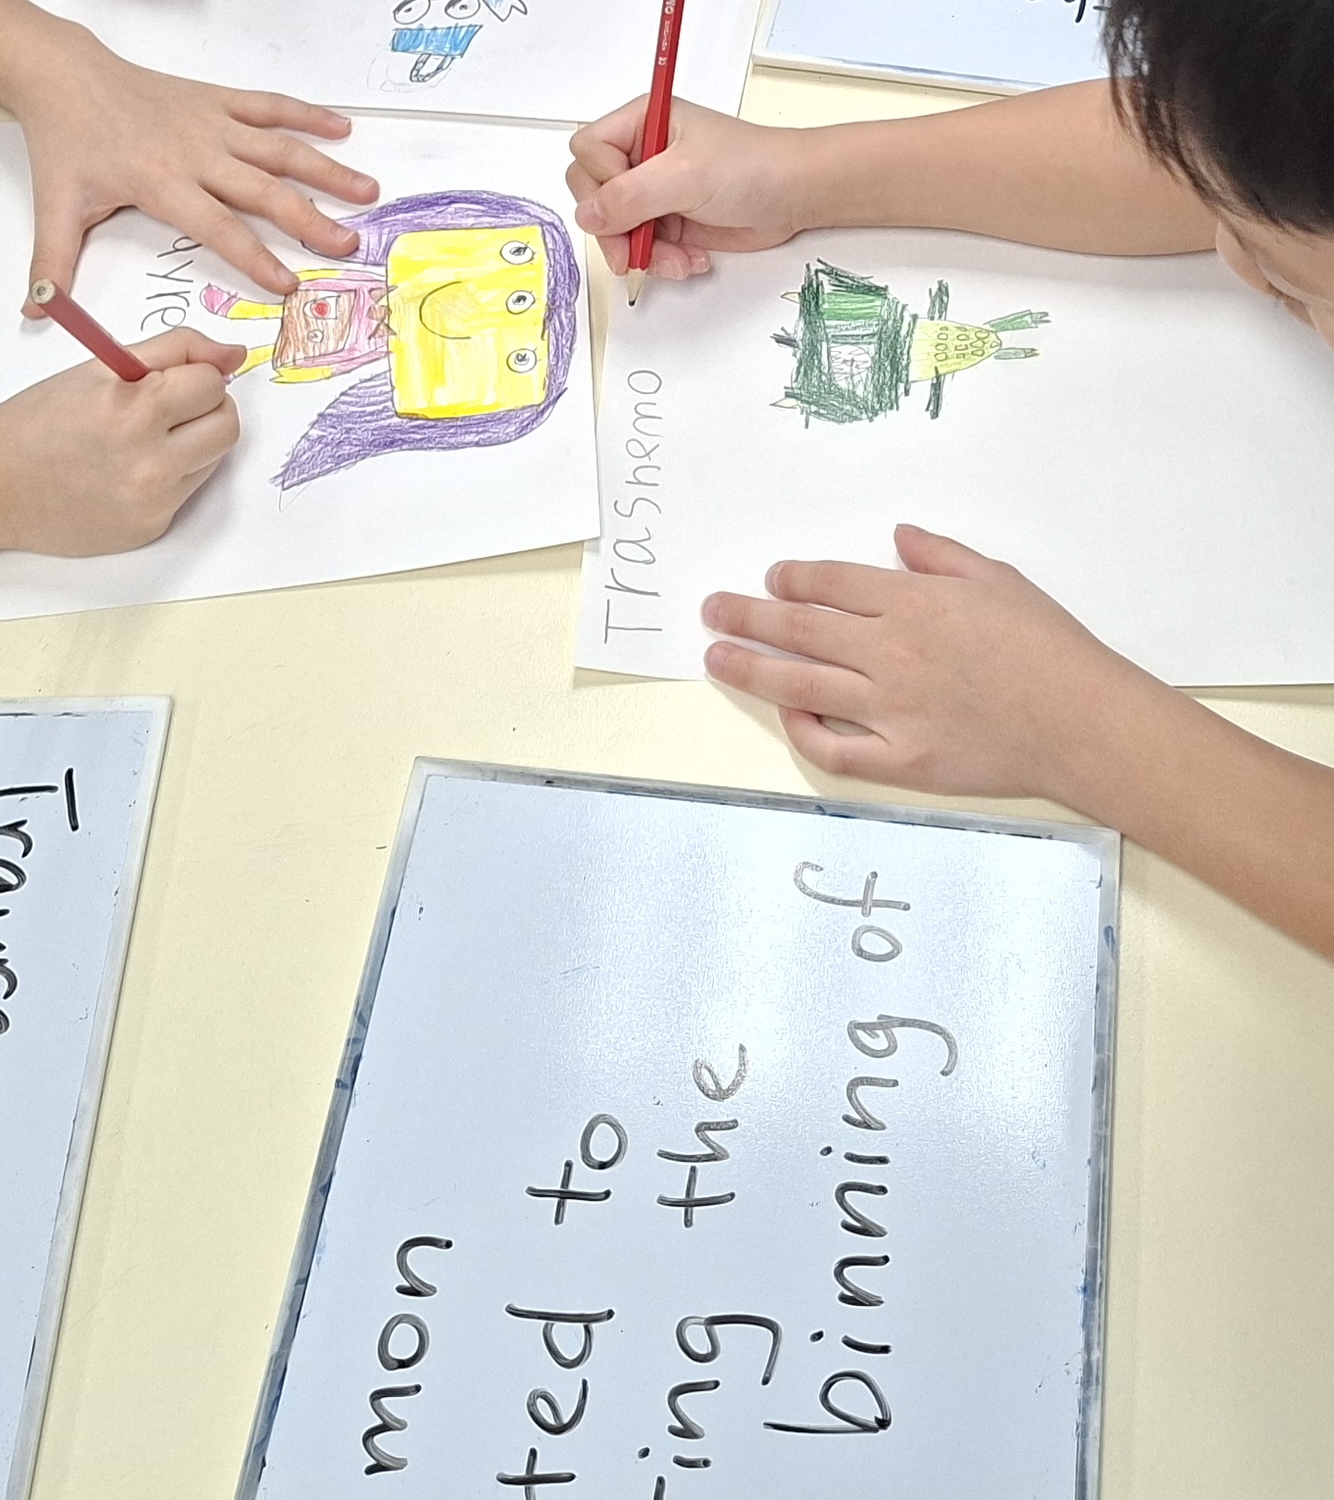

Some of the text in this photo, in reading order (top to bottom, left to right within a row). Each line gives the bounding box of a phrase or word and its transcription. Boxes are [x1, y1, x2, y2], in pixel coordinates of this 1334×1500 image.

[525, 1114, 628, 1225] to
[637, 1043, 782, 1500] ing the
[763, 860, 959, 1435] binning of
[362, 1236, 453, 1476] mon
